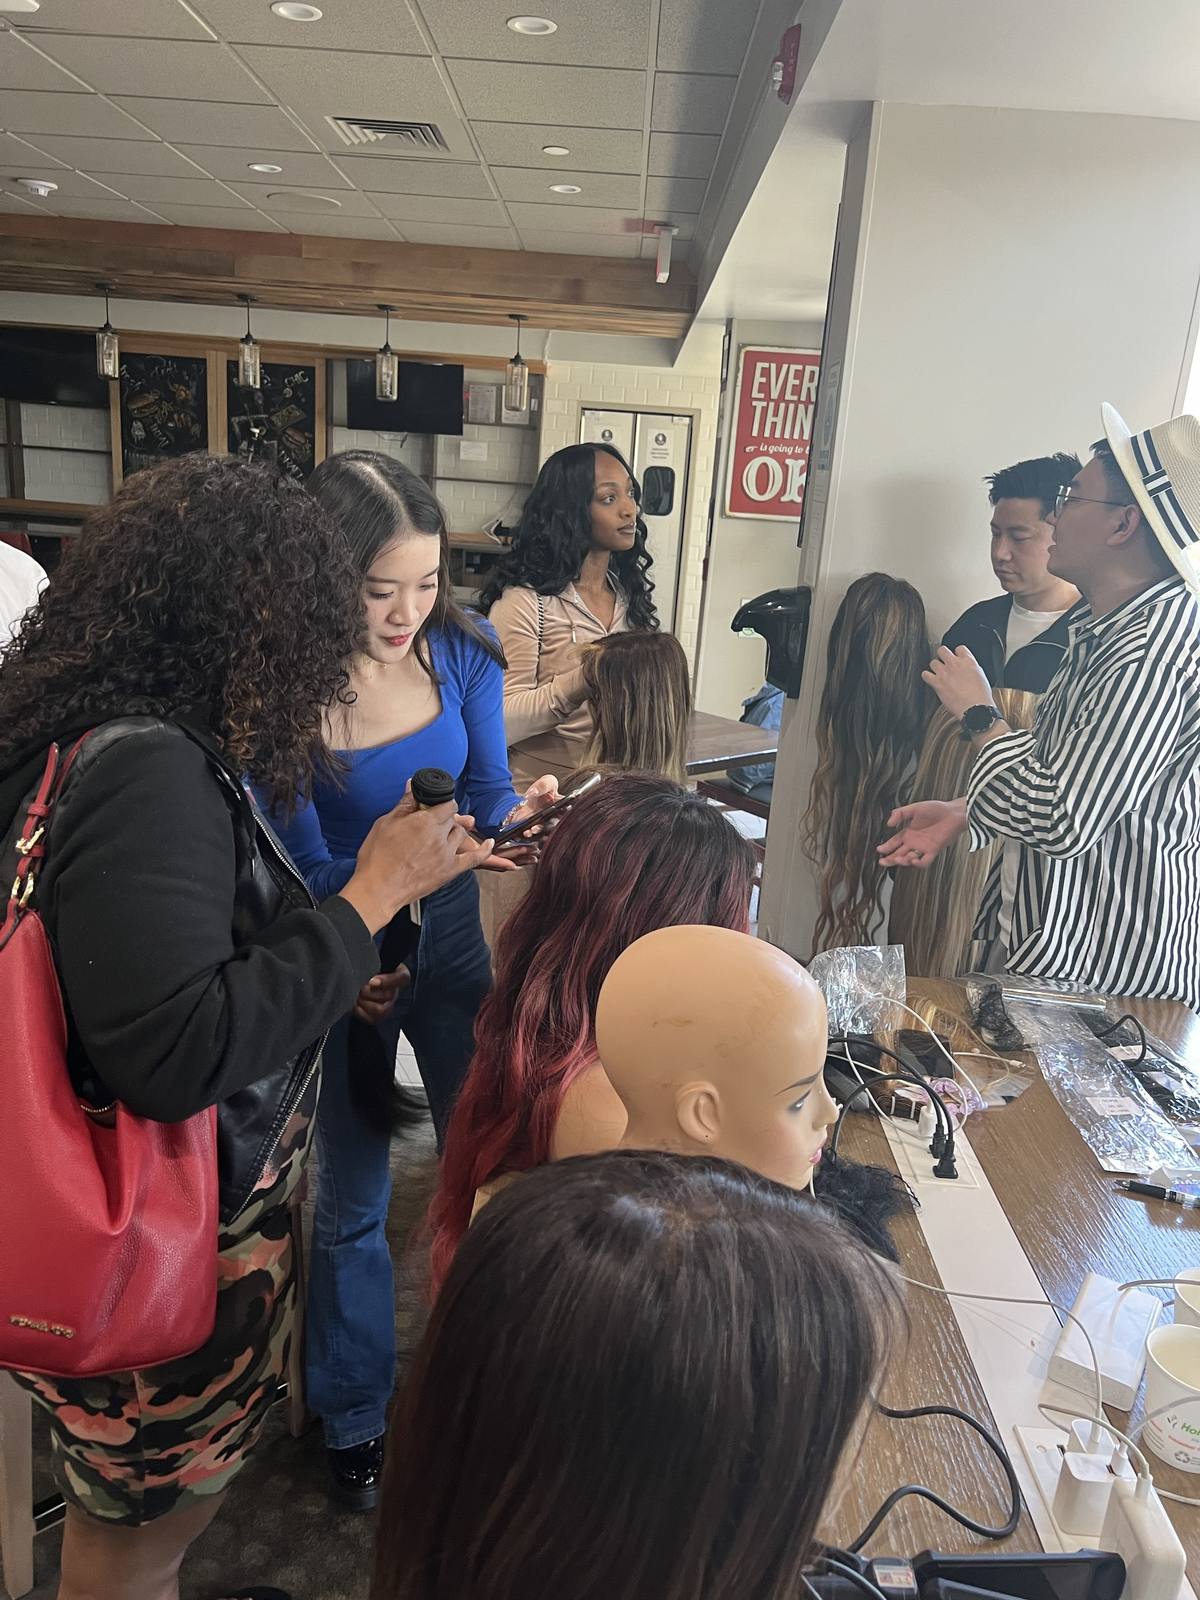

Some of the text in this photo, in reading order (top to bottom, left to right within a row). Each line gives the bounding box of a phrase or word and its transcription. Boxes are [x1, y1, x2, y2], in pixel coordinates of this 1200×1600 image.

[751, 361, 819, 402] EVER
[760, 442, 768, 452] is
[768, 443, 794, 455] going
[794, 445, 804, 454] to
